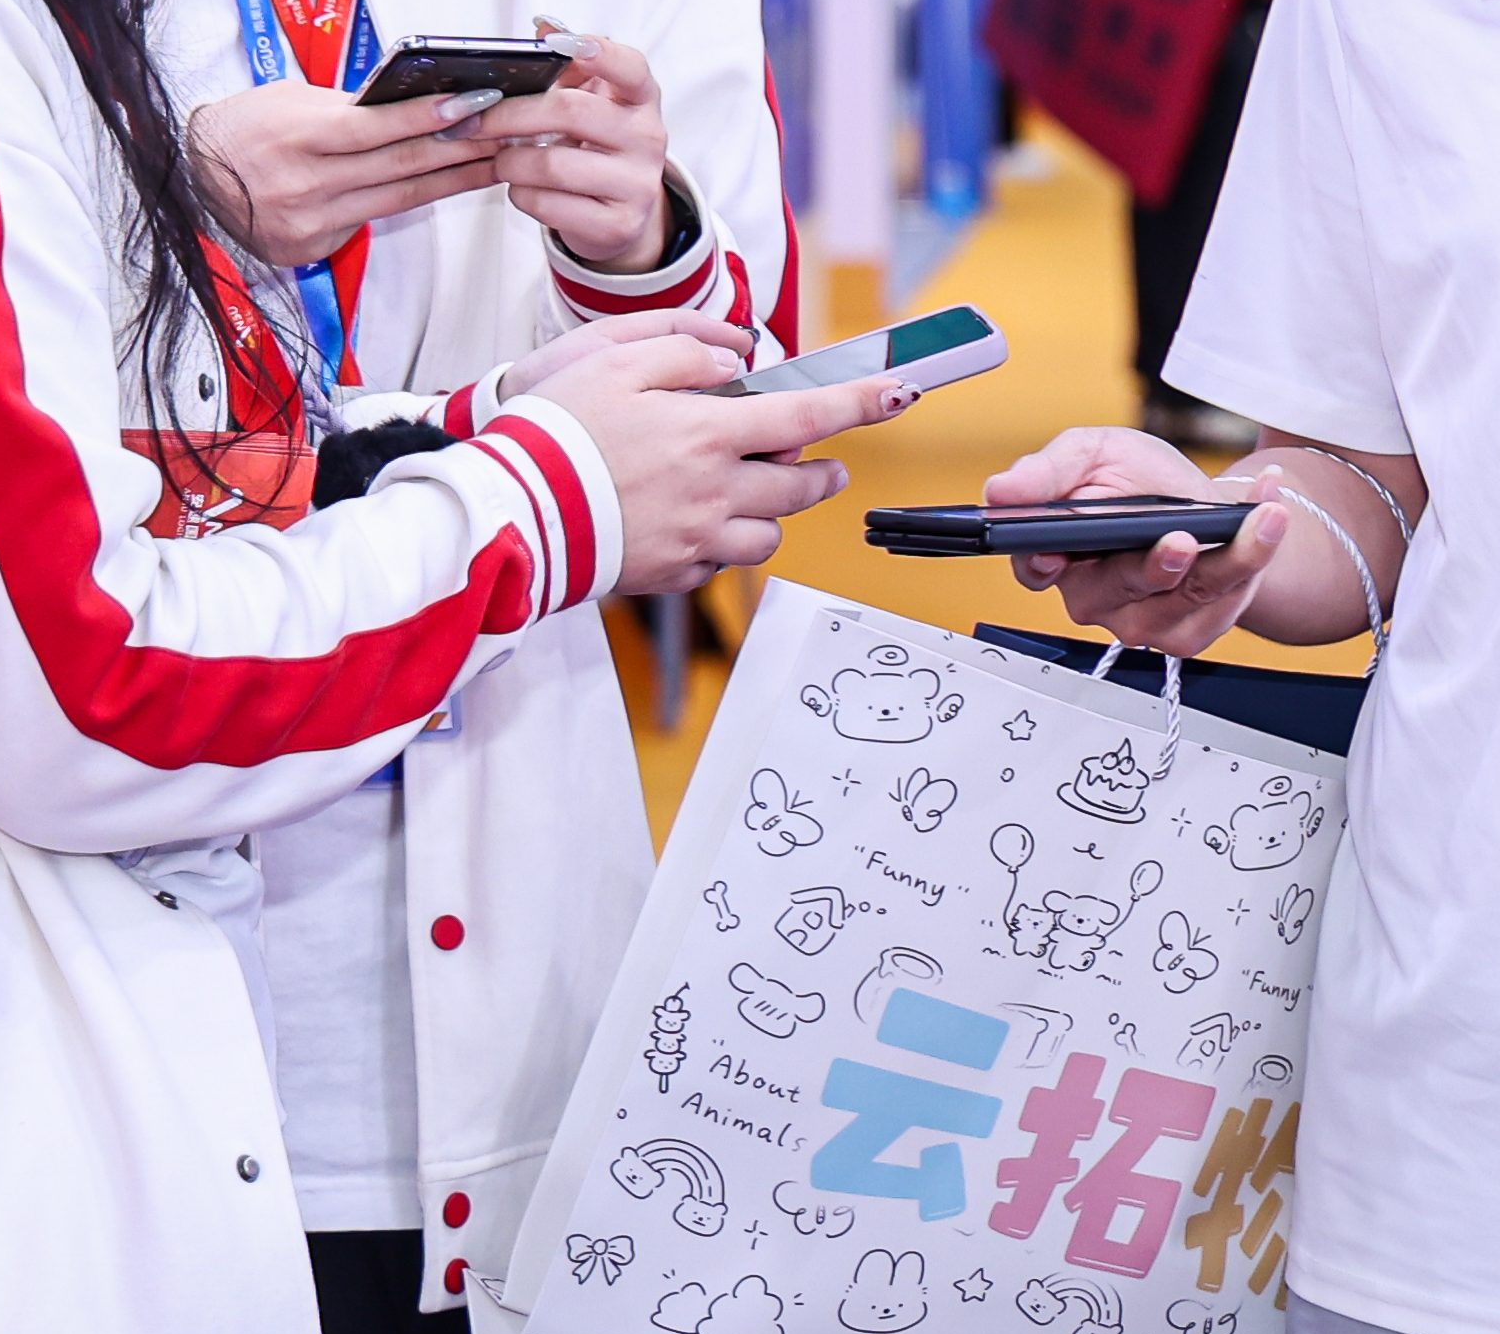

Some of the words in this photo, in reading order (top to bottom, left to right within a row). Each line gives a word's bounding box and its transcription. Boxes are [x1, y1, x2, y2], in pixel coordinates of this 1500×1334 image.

[680, 1091, 809, 1153] Animals
[810, 986, 1299, 1313] 云拓物
